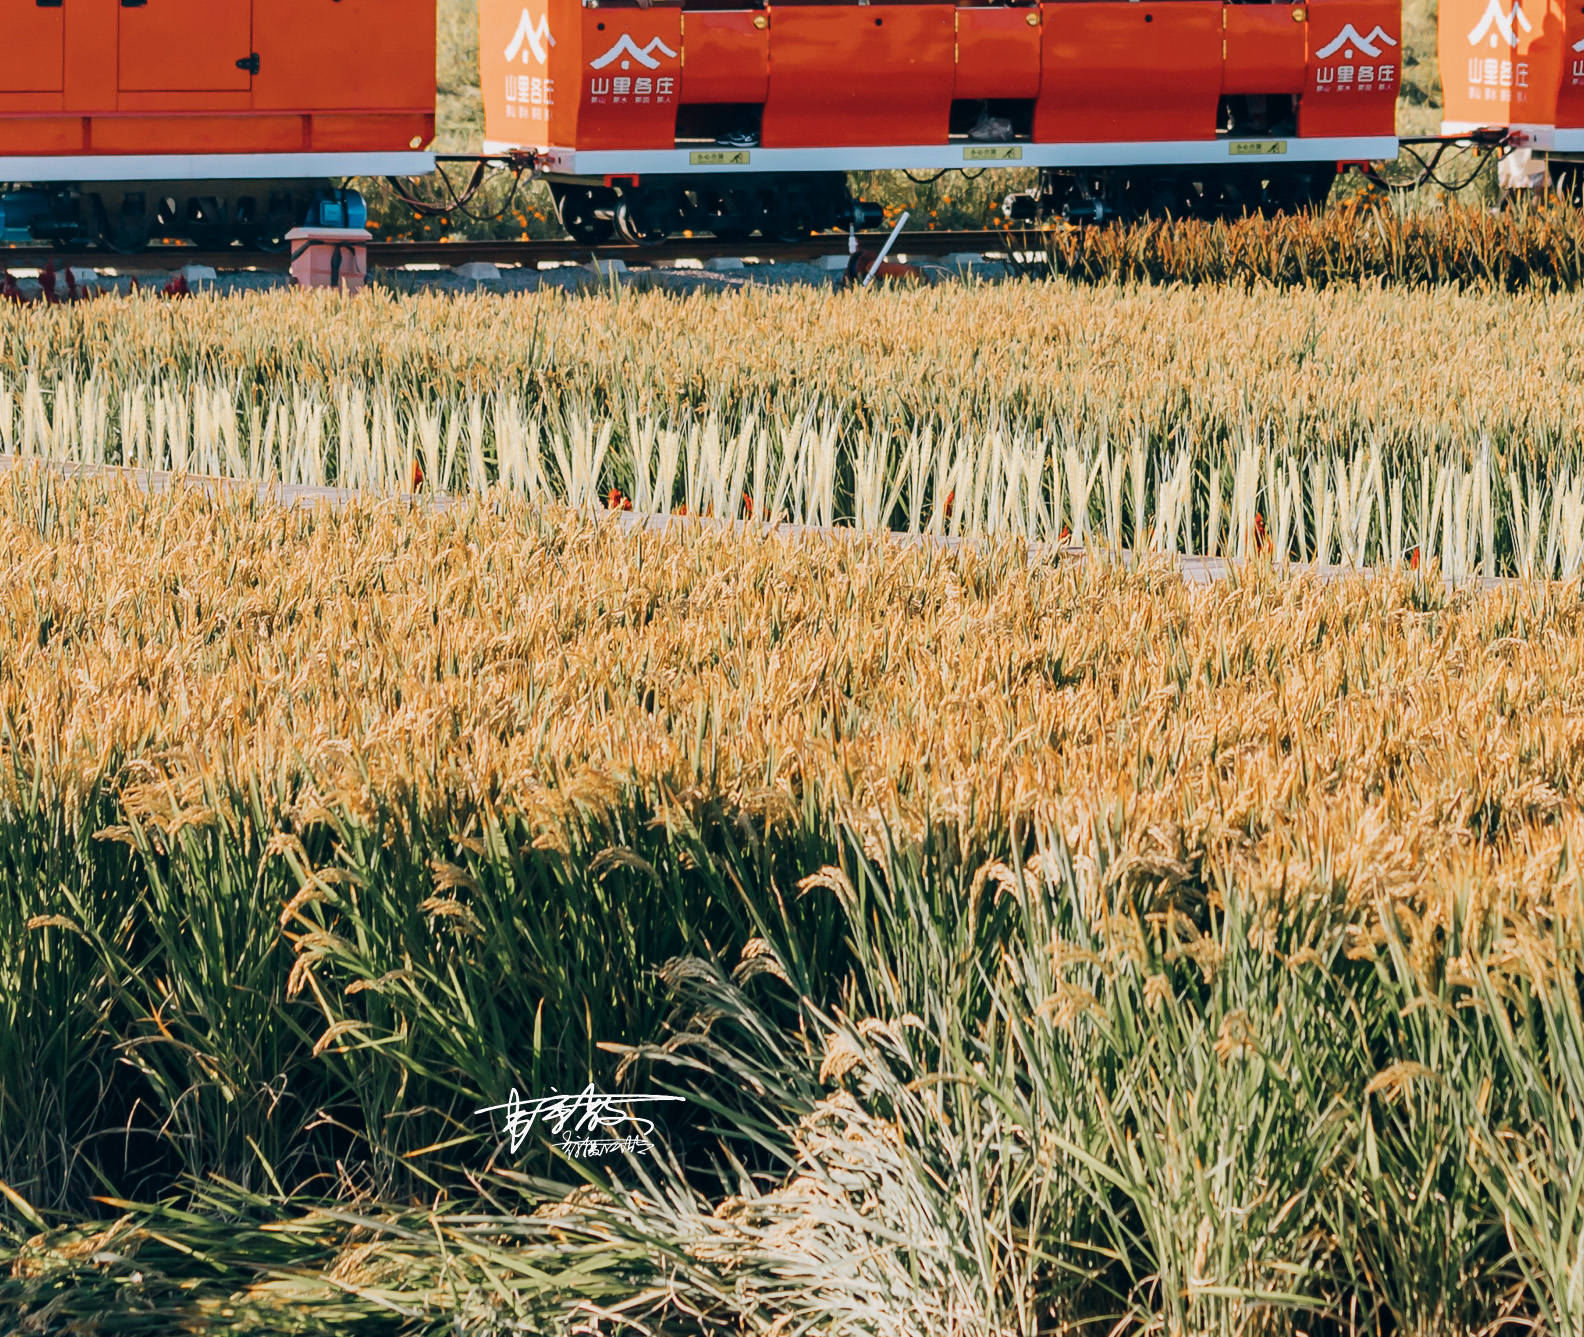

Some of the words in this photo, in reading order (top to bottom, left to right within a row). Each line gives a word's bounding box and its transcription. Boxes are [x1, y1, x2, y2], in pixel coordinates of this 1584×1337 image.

[1317, 65, 1395, 83] 山里各庄
[1468, 56, 1528, 87] 山里各庄
[504, 74, 555, 105] 山里各庄
[591, 76, 674, 95] 山里各庄
